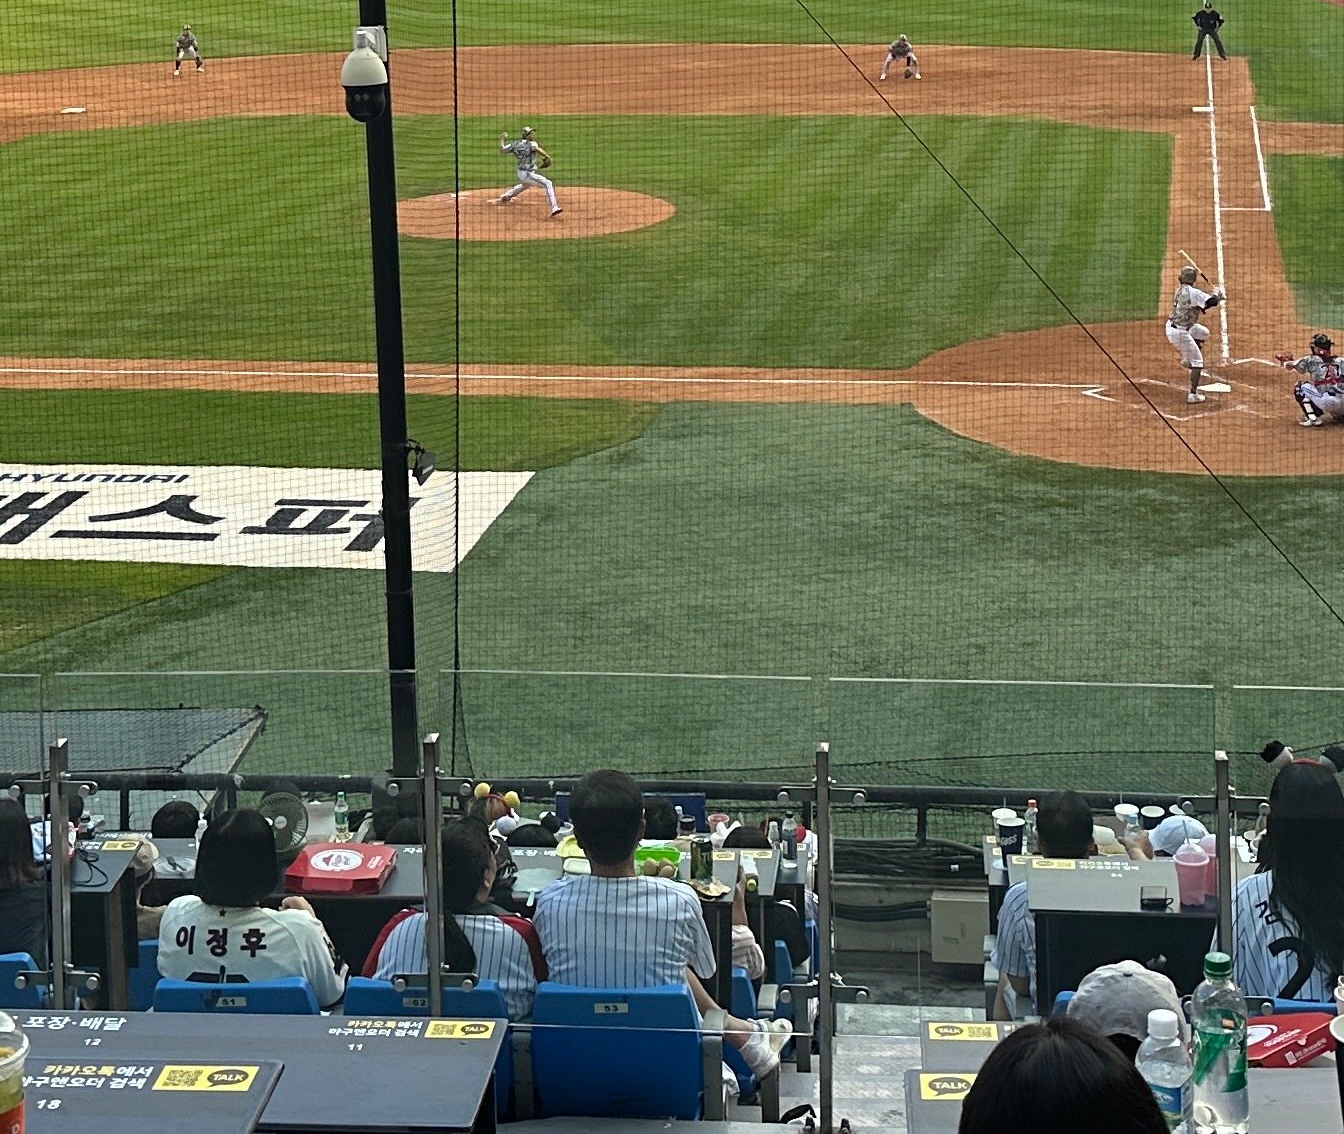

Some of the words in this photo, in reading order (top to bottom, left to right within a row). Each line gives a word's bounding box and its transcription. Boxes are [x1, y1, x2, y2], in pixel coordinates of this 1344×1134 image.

[175, 925, 267, 958] 이정후
[935, 1027, 962, 1036] TALK
[43, 1065, 155, 1077] 카카오톡에서
[212, 1073, 245, 1082] TALK
[109, 1078, 148, 1090] 검색
[930, 1079, 969, 1092] TALK
[36, 1099, 61, 1110] 18
